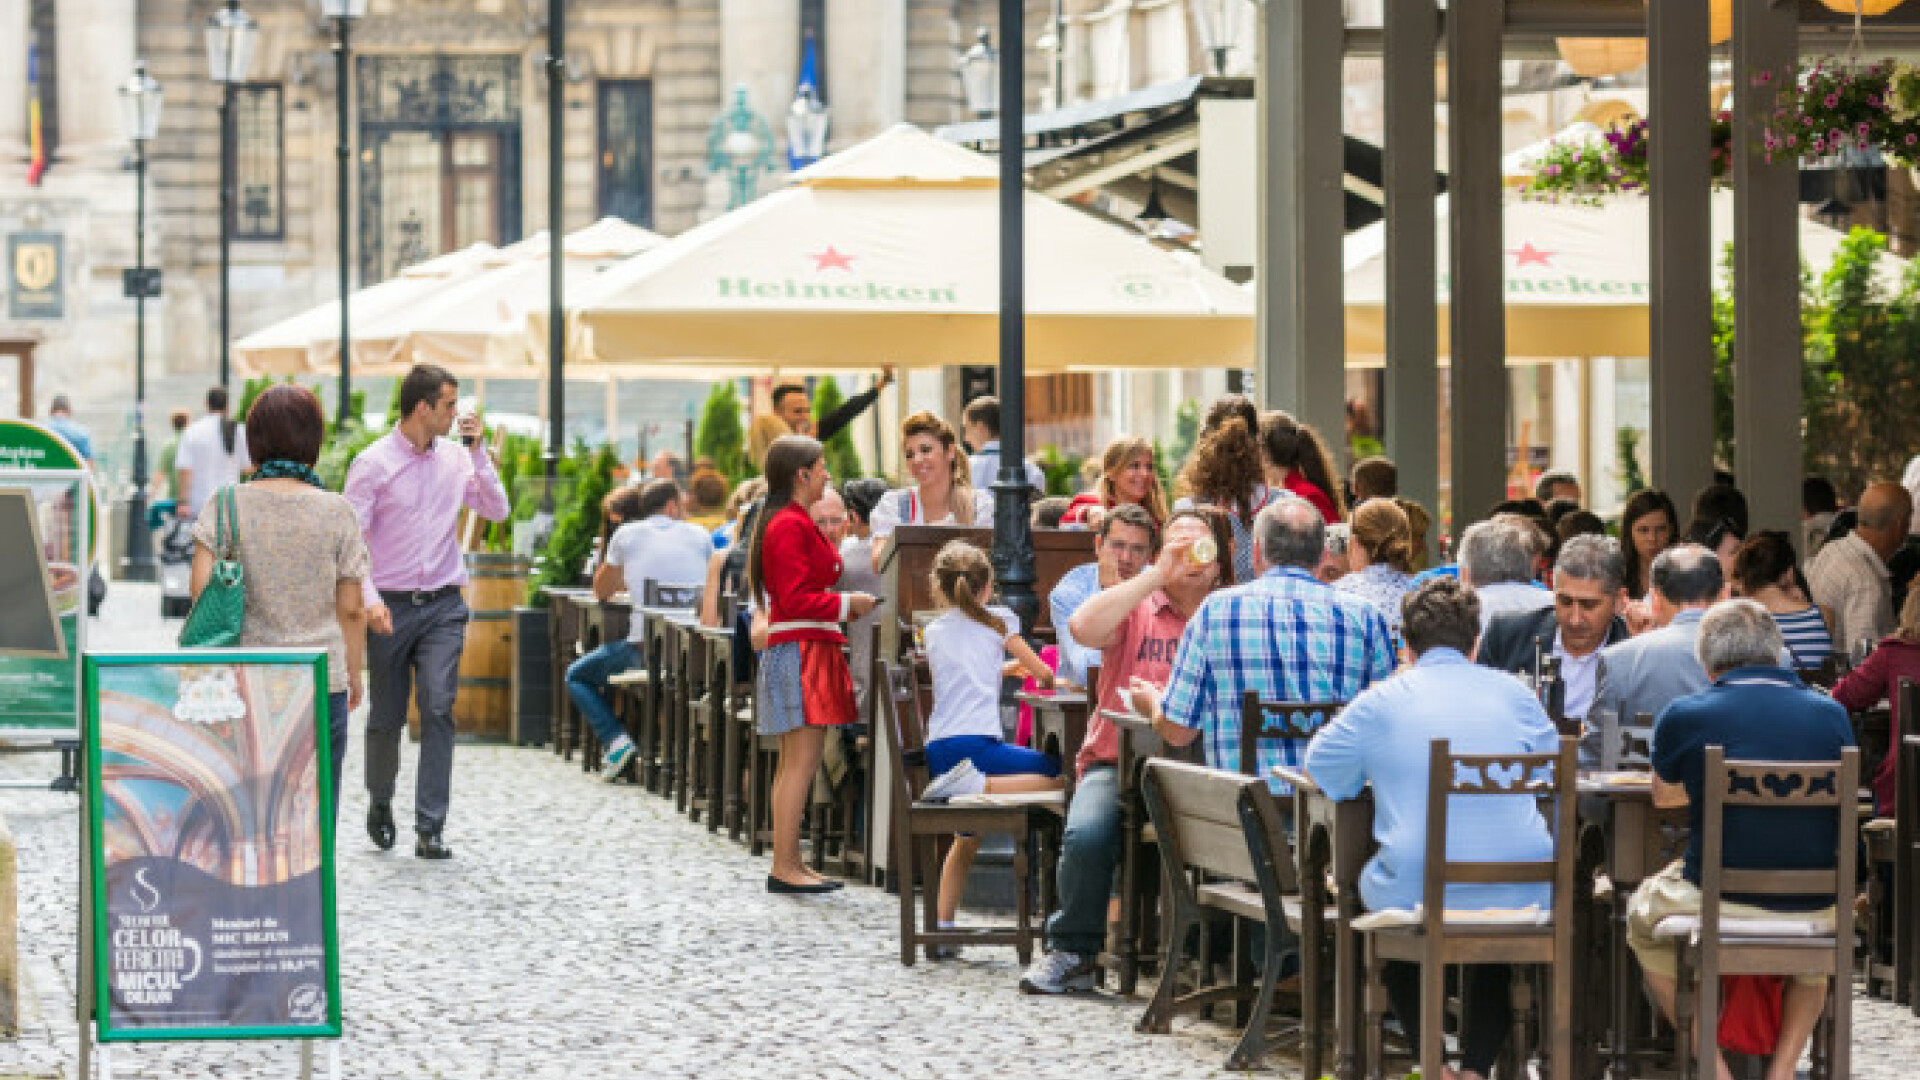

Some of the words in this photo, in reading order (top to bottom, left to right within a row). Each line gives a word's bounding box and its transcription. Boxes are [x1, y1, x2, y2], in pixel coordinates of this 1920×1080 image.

[716, 277, 958, 303] Heineken
[113, 929, 182, 948] CELOR
[211, 931, 241, 944] MIC
[118, 971, 182, 990] MICUL
